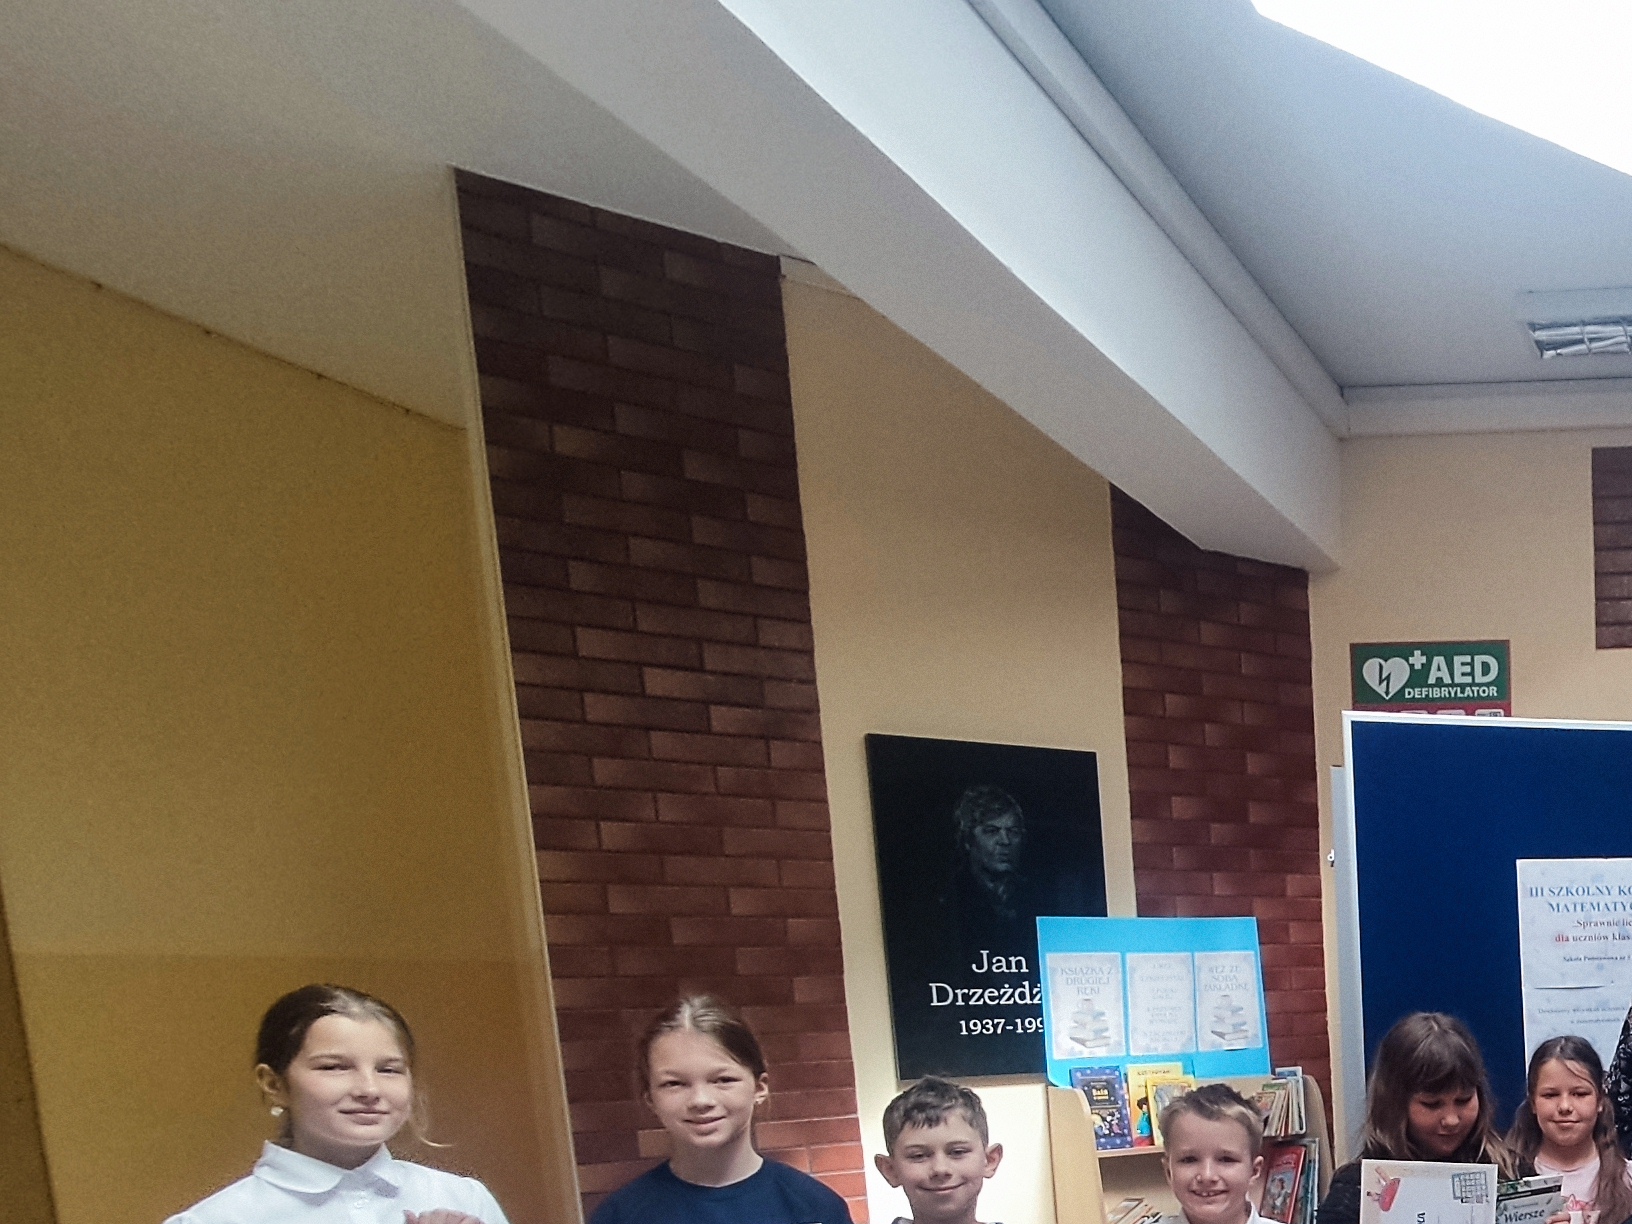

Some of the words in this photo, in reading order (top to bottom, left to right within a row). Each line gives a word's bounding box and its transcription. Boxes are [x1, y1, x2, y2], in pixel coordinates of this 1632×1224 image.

[1427, 654, 1499, 684] AED
[1404, 686, 1498, 699] DEFIBRYLATOR
[1529, 886, 1544, 897] III
[1548, 885, 1612, 897] SZKOLNY
[1555, 933, 1570, 942] dla
[1572, 932, 1609, 942] uczniów
[971, 950, 1029, 974] Jan
[928, 981, 1042, 1006] Drzeżdż
[959, 1017, 1044, 1035] 1937-199
[1504, 1209, 1545, 1223] Wiersze
